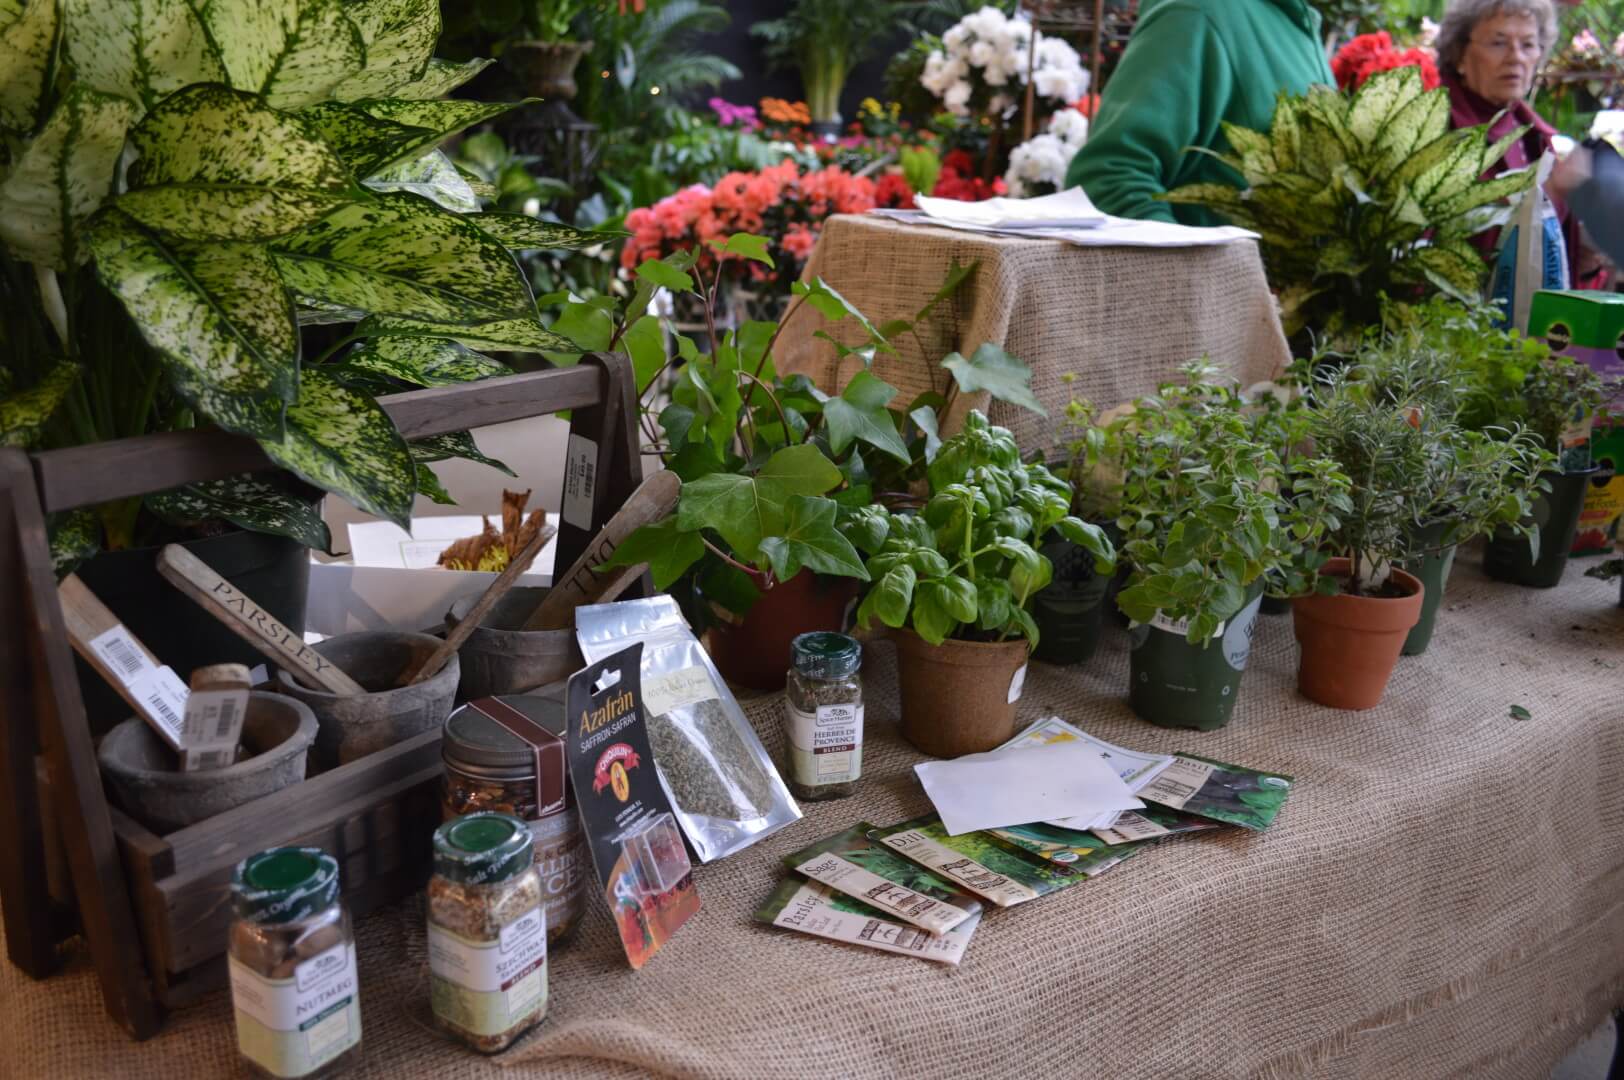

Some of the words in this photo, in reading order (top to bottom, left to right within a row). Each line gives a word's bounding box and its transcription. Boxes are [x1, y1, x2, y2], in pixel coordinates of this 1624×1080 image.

[564, 537, 616, 595] DILL
[213, 582, 330, 672] PARSLEY
[579, 689, 634, 737] Azafrán
[814, 729, 845, 739] HERBES
[846, 728, 856, 736] DE
[814, 736, 856, 746] PROVENCE
[1175, 757, 1209, 772] Basil
[888, 832, 926, 847] Dill
[805, 859, 839, 876] Sage
[782, 894, 825, 926] Parsley
[296, 978, 353, 1017] NUTMEG
